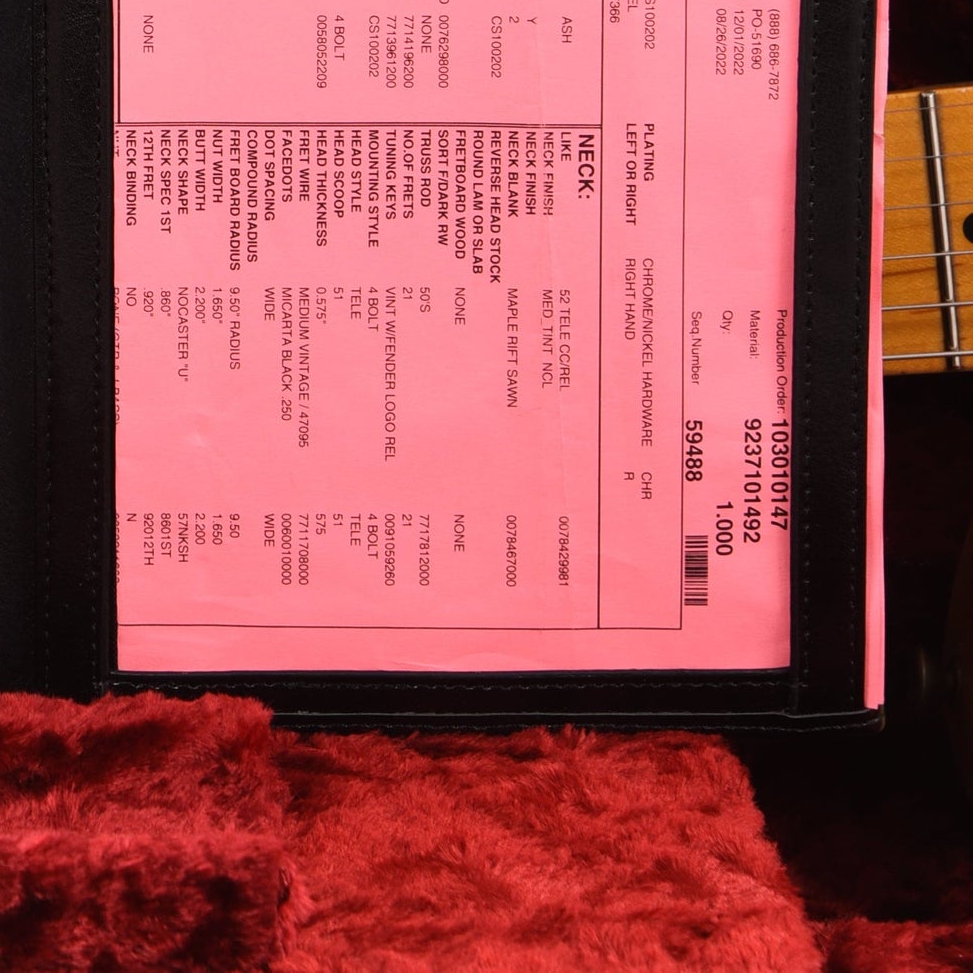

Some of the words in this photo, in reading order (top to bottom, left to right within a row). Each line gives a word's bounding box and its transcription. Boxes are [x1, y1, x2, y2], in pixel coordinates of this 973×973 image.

[716, 9, 726, 75] 08/26/2022
[734, 9, 744, 75] 12/01/2022
[751, 9, 762, 69] PO-51690
[767, 9, 780, 39] (888)
[438, 15, 449, 88] 0076298000
[769, 44, 779, 100] 686-7872
[143, 130, 154, 161] 12TH
[386, 129, 396, 180] TUNING
[626, 123, 637, 156] LEFT
[644, 123, 654, 181] PLATING
[144, 166, 154, 200] FRET
[578, 135, 595, 199] NECK:
[626, 160, 637, 180] OR
[386, 185, 396, 219] KEYS
[626, 184, 636, 226] RIGHT
[386, 287, 396, 316] VINT
[625, 259, 636, 299] RIGHT
[625, 303, 635, 340] HAND
[642, 258, 654, 367] CHROME/NICKEL
[720, 310, 733, 333] Qty:
[750, 310, 760, 358] Material:
[385, 320, 396, 389] W/FENDER
[776, 310, 787, 372] Production
[385, 394, 396, 432] LOGO
[641, 372, 652, 446] HARDWARE
[777, 376, 787, 413] Order:
[385, 437, 395, 461] REL
[683, 420, 703, 482] 59488
[771, 419, 788, 530] 103010147
[624, 472, 634, 480] R
[641, 472, 652, 499] CHR
[743, 418, 762, 543] 9237101492
[143, 513, 154, 565] 92012TH
[385, 514, 395, 586] 0091059260
[716, 501, 734, 556] 1.000
